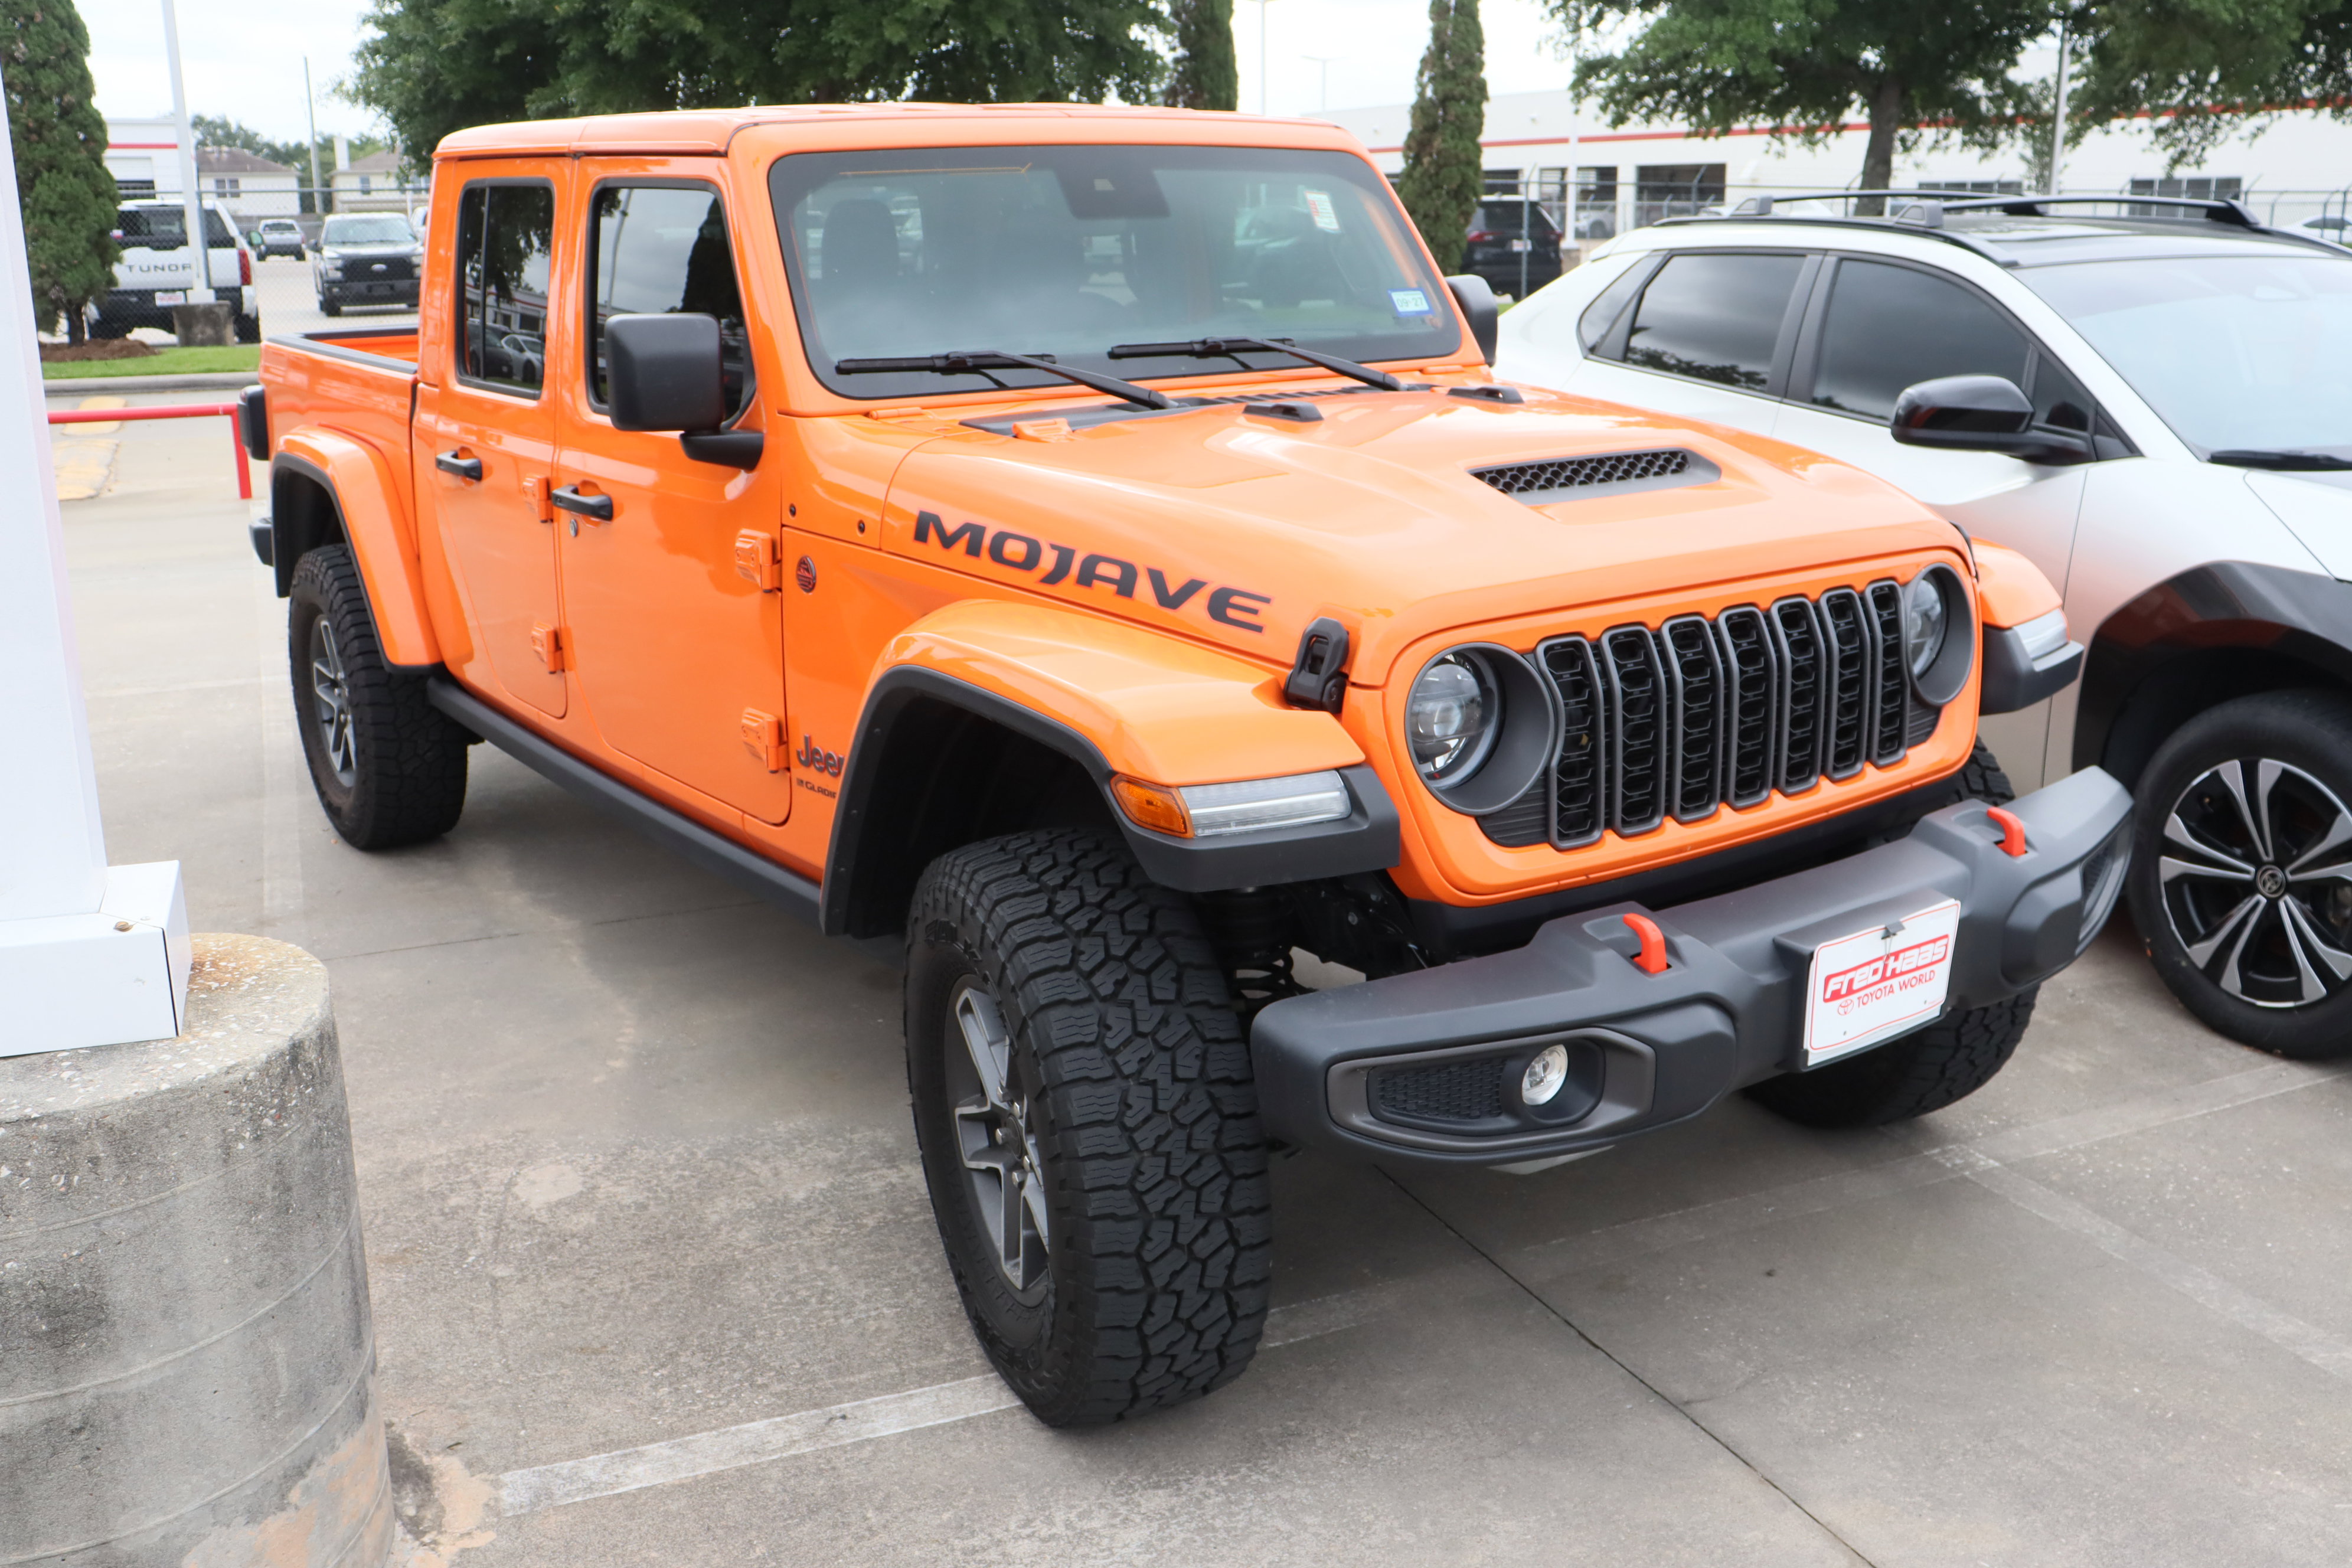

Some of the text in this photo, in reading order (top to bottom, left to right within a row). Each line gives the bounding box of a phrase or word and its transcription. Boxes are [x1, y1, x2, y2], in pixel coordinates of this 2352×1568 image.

[127, 263, 192, 273] TUNDR
[913, 509, 1272, 633] MOJAVE
[1857, 969, 1936, 1008] TOYOTA WORLD
